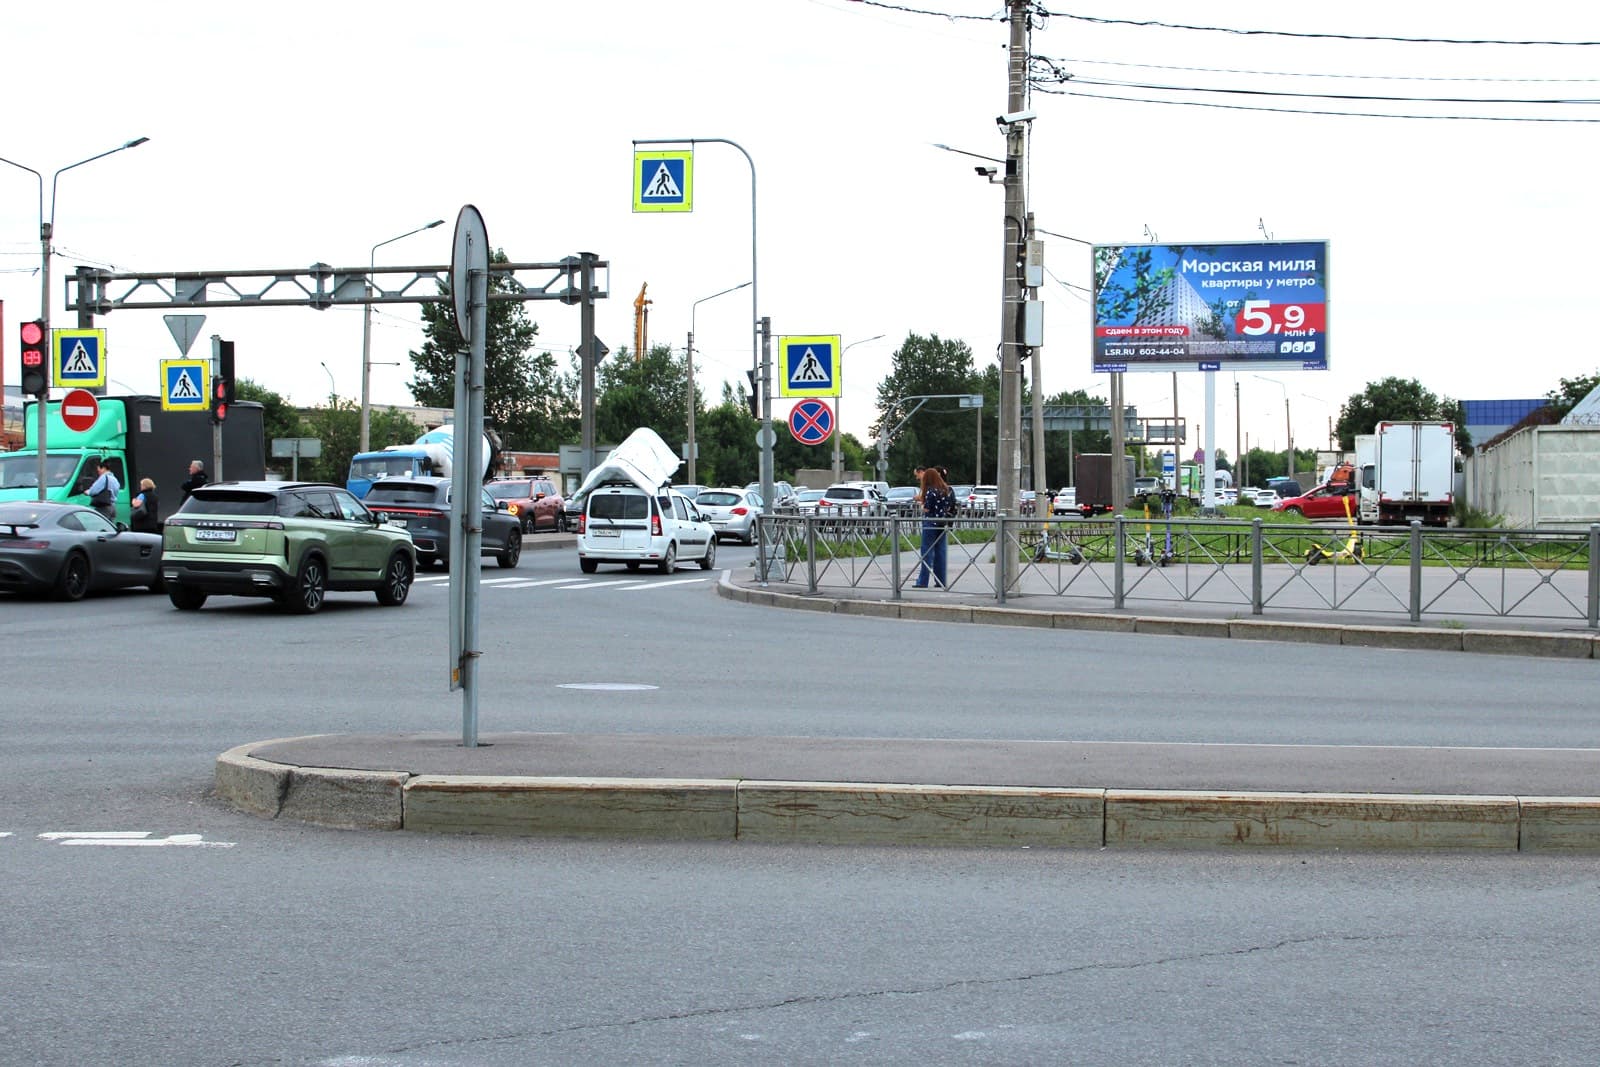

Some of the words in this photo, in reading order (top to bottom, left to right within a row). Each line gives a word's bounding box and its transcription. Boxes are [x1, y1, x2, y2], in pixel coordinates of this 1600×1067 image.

[1182, 259, 1263, 276] Морская
[1268, 260, 1316, 271] миля
[1202, 279, 1262, 289] квартиры
[1266, 279, 1273, 288] у
[1276, 278, 1315, 288] метро
[1242, 300, 1305, 335] 5,9
[1164, 327, 1185, 335] году
[1105, 348, 1135, 356] LSR.RU
